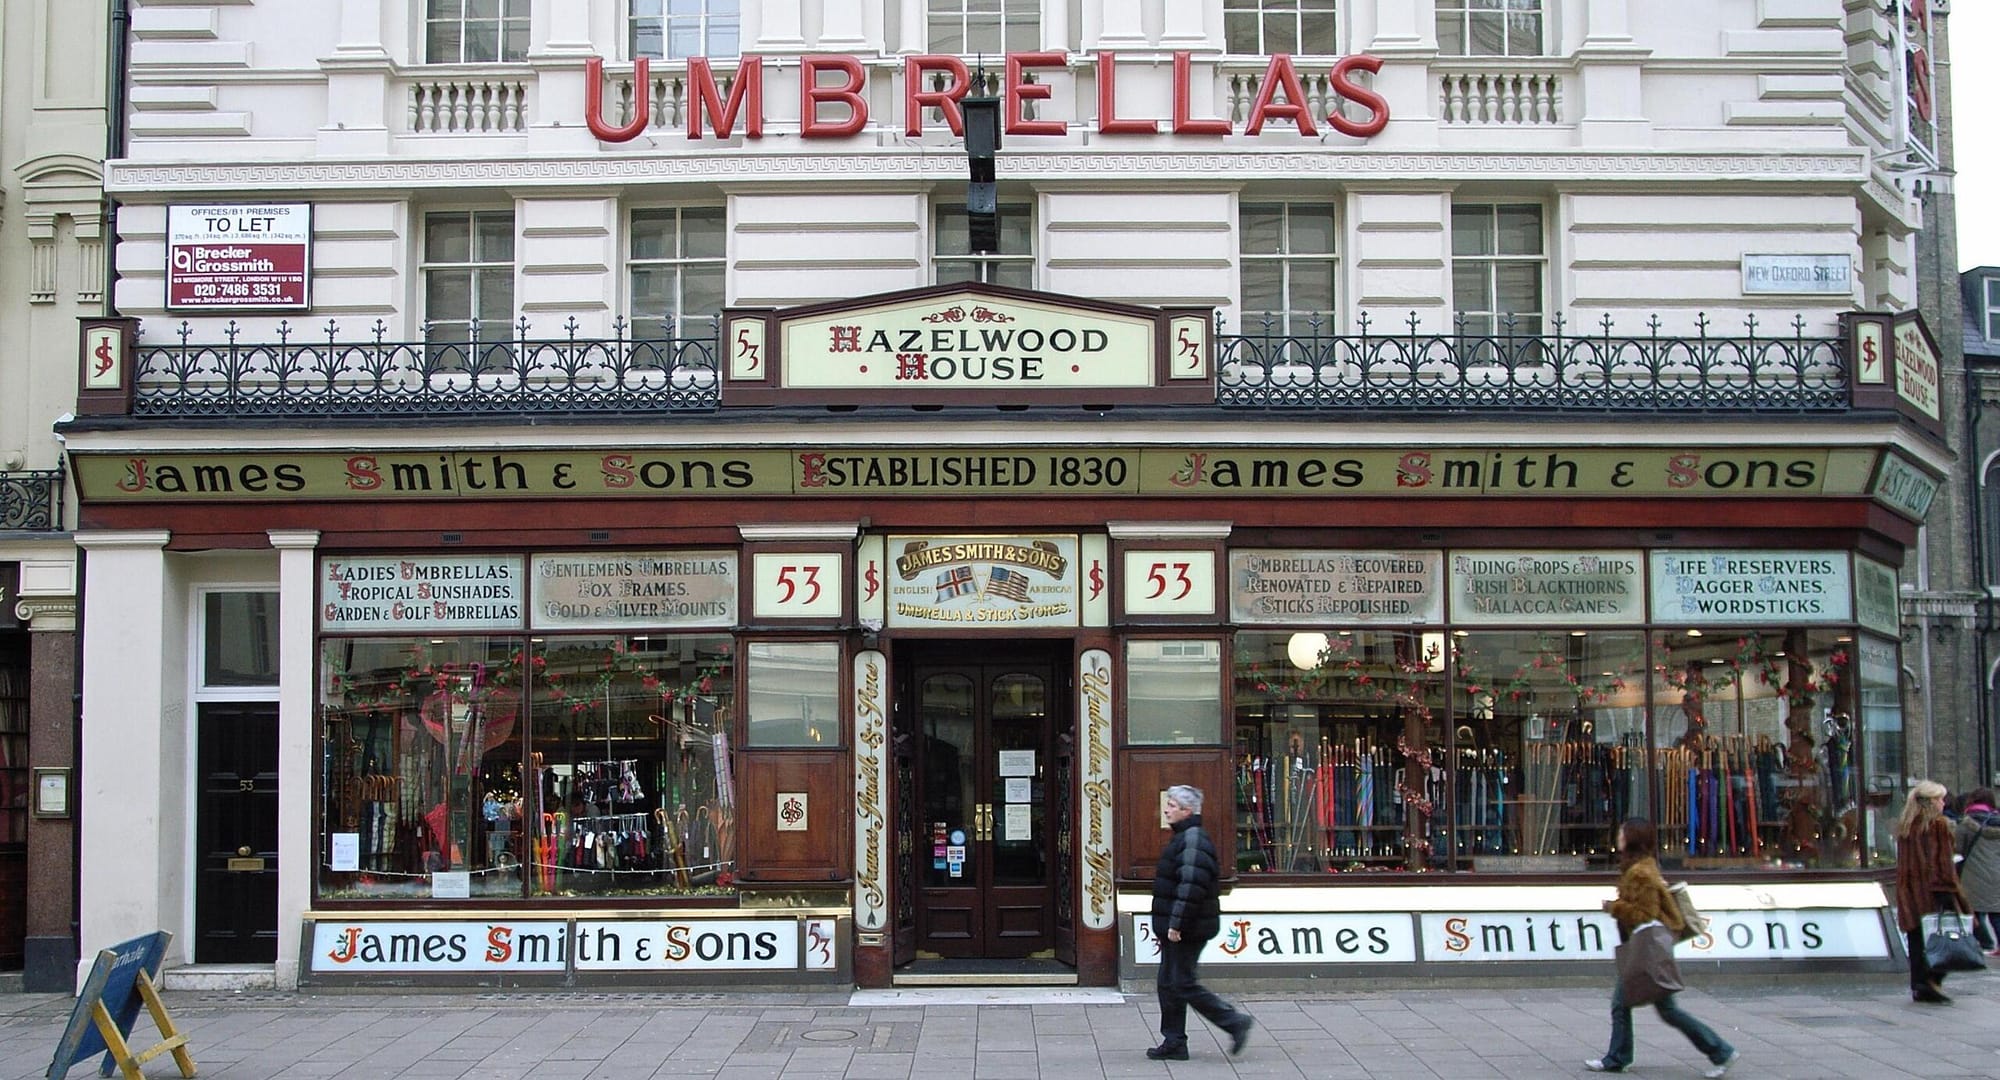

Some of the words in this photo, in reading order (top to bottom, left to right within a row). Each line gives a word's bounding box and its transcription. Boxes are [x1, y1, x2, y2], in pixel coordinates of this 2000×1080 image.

[584, 51, 1390, 143] UMBRELLAS
[247, 207, 290, 216] PREMISES
[205, 218, 231, 232] TO
[239, 217, 276, 232] LET
[196, 246, 252, 260] Brecker
[196, 259, 274, 273] Grossmith
[1748, 265, 1769, 281] NEW
[1772, 265, 1811, 281] OXFORD
[1813, 264, 1848, 282] STREET
[253, 283, 281, 296] 3531
[829, 325, 1109, 354] HAZELWOOD
[1178, 328, 1200, 370] 53
[737, 329, 760, 371] 53
[896, 354, 1044, 381] HOUSE
[116, 456, 306, 493] James
[344, 454, 529, 491] Smith
[601, 454, 754, 489] Sons
[799, 453, 1036, 488] ESTABLISHED
[1048, 456, 1127, 487] 1830
[1168, 452, 1364, 488] James
[1397, 451, 1578, 488] Smith
[1666, 453, 1816, 488] Sons
[638, 557, 731, 577] UMBRELLAS.
[901, 545, 952, 571] JAMES
[954, 544, 1003, 561] SMITH
[1247, 555, 1335, 574] UMBRELLAS
[1339, 555, 1426, 575] RECOVERED.
[1455, 556, 1515, 576] RIDING
[1519, 556, 1569, 575] CROPS
[1579, 555, 1637, 575] WHIPS.
[1665, 556, 1707, 576] LIFE
[1712, 556, 1836, 576] PRESERVERS.
[400, 560, 513, 581] UMBRELLAS.
[578, 579, 612, 598] FOX
[619, 578, 690, 598] FRAMES.
[777, 566, 822, 604] 53
[1146, 562, 1191, 600] 53
[1246, 575, 1331, 594] RENOVATED
[1352, 575, 1424, 594] REPAIRED.
[1467, 576, 1507, 595] IRISH
[1512, 576, 1629, 595] BLACKTHORNS.
[1675, 576, 1754, 594] DAGGER
[1758, 576, 1827, 595] CANES.
[338, 582, 413, 601] TROPICAL
[417, 582, 514, 600] SUNSHADES.
[324, 602, 380, 622] GARDEN
[392, 602, 431, 621] GOLF
[433, 600, 521, 620] UMBRELLAS.
[545, 600, 590, 619] GOLD
[606, 599, 658, 618] SILVER
[661, 598, 726, 617] MOUNTS
[896, 602, 962, 621] UMBRELLA
[966, 608, 975, 621] &
[977, 608, 1017, 622] STICK
[1020, 602, 1072, 621] STORES.
[1261, 596, 1314, 614] STICKS
[1318, 596, 1412, 615] REPOLISHED.
[1474, 597, 1557, 615] MALACCA
[1560, 597, 1621, 615] CANES.
[1681, 595, 1825, 615] SWORDSTICKS.
[240, 780, 253, 792] 53
[328, 927, 467, 963] James
[484, 924, 620, 963] Smith
[664, 924, 777, 961] Sons
[809, 922, 830, 965] 53
[1139, 922, 1161, 956] 53
[1219, 917, 1390, 956] James
[1444, 916, 1604, 955] Smith
